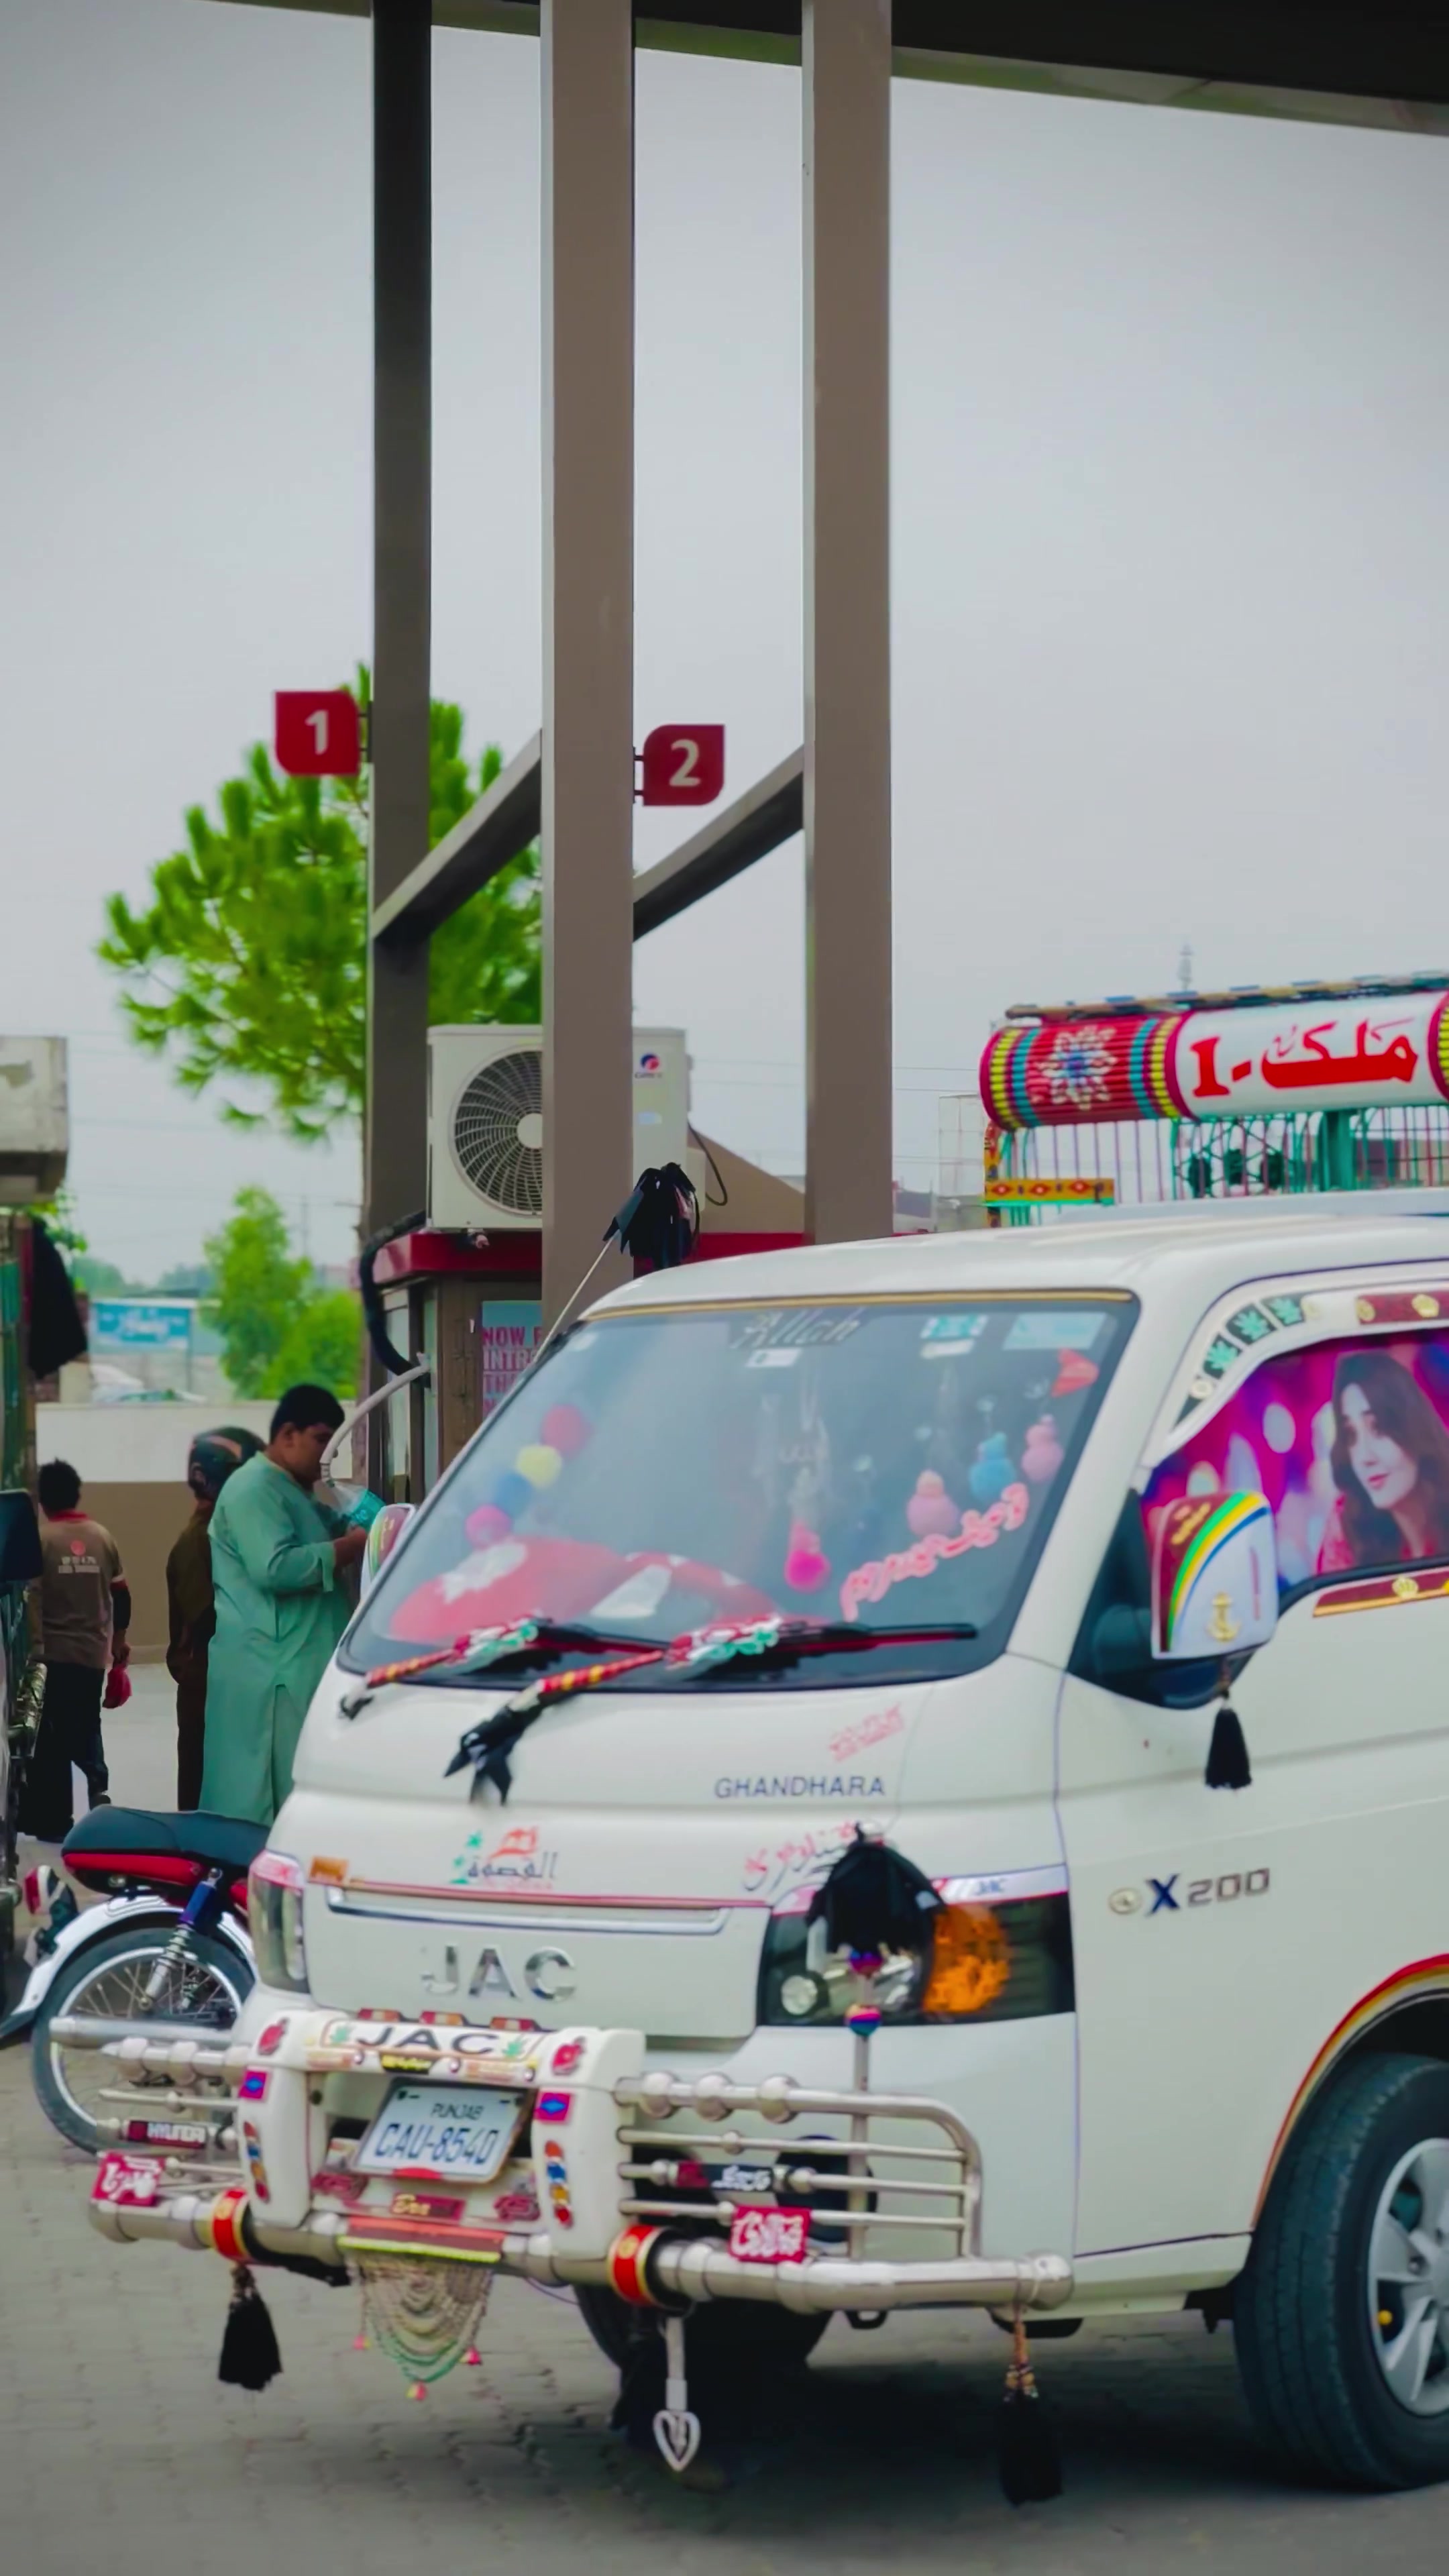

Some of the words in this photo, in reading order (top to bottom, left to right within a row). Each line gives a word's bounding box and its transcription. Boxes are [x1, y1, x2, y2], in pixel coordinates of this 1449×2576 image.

[305, 710, 328, 755] 1
[668, 739, 702, 786] 2
[482, 1326, 525, 1346] NOW
[715, 1776, 885, 1799] GHANDHARA
[421, 1943, 576, 2002] JAC
[356, 2026, 498, 2055] JAC
[431, 2102, 484, 2121] PUNJAB
[374, 2123, 500, 2165] CAU-8540
